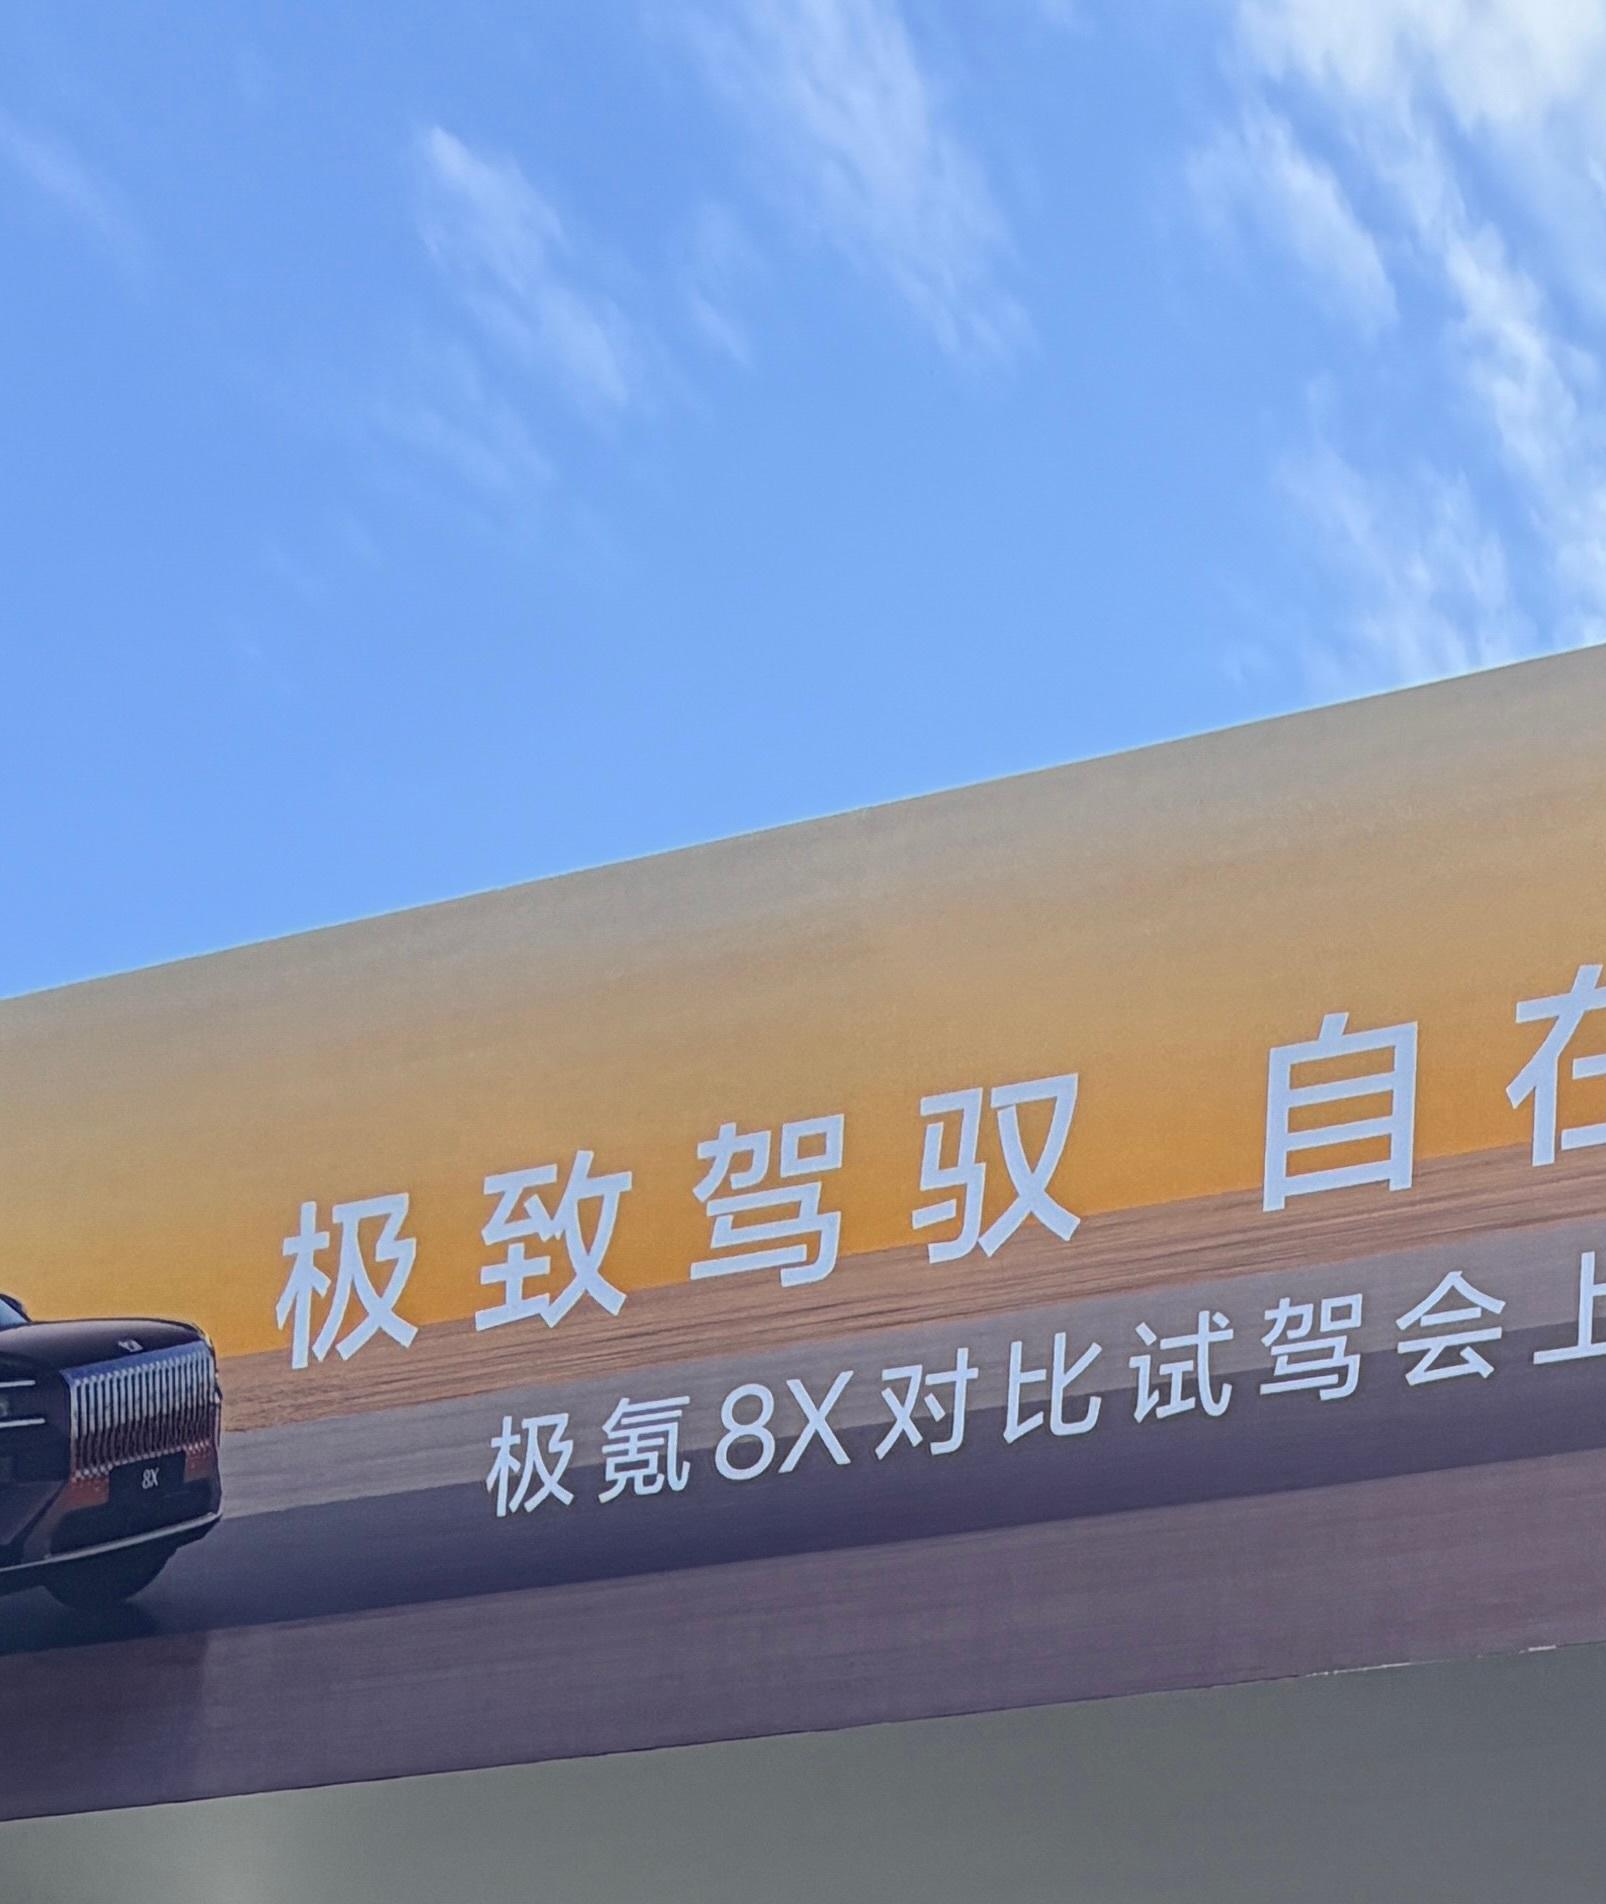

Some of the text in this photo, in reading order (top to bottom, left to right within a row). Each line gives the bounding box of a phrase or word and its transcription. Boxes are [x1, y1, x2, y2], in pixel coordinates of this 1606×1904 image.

[276, 1073, 1083, 1370] 极致驾驭
[142, 1467, 159, 1489] 8X
